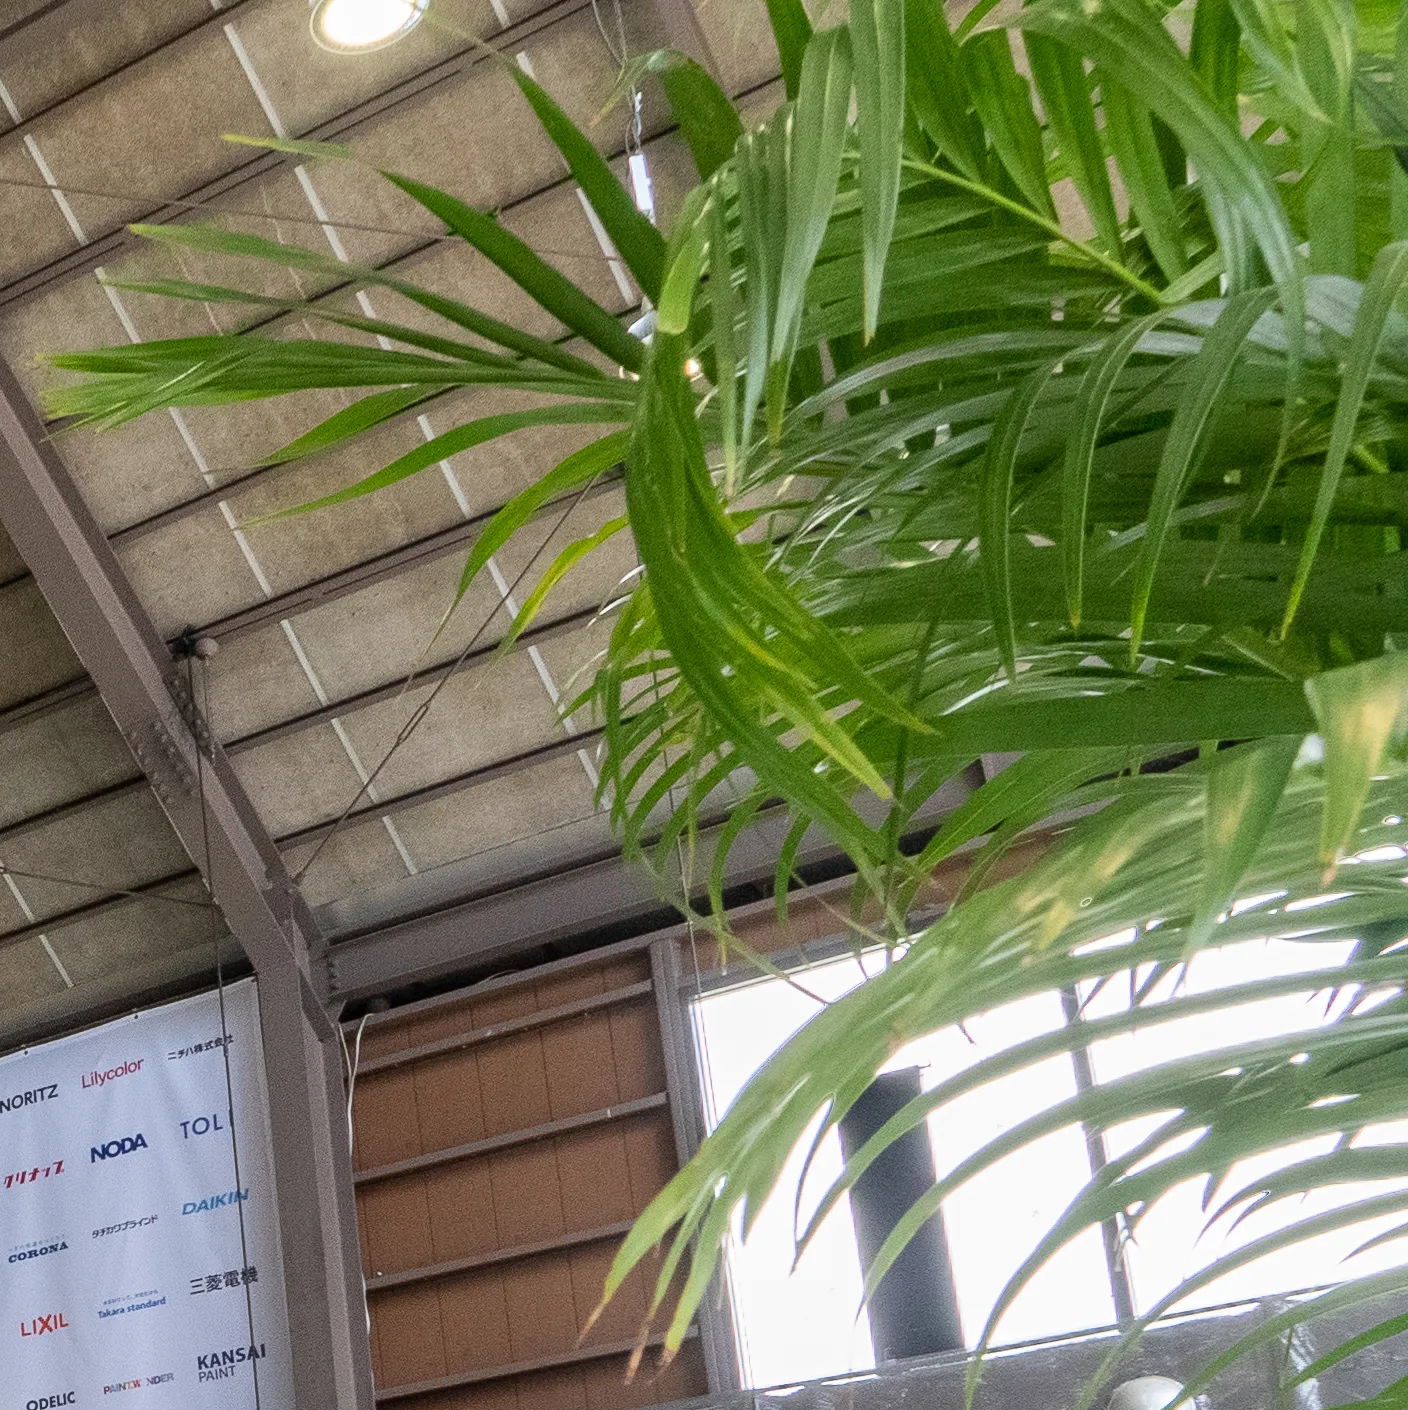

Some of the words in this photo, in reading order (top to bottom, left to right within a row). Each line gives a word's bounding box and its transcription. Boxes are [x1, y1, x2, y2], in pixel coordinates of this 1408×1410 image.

[167, 1034, 234, 1060] ニチハ株式会社
[81, 1058, 144, 1089] Lilycolor
[0, 1084, 59, 1113] NORITZ
[91, 1132, 148, 1163] NODA
[182, 1188, 249, 1216] DAIKIN
[92, 1214, 158, 1239] タチカワブラインド
[8, 1241, 69, 1263] CORONA
[190, 1266, 259, 1295] 三菱電機
[98, 1306, 125, 1319] Takara
[127, 1297, 166, 1313] standard
[20, 1313, 69, 1337] LIXIL
[197, 1343, 267, 1370] KANSAI
[198, 1365, 236, 1383] PAINT
